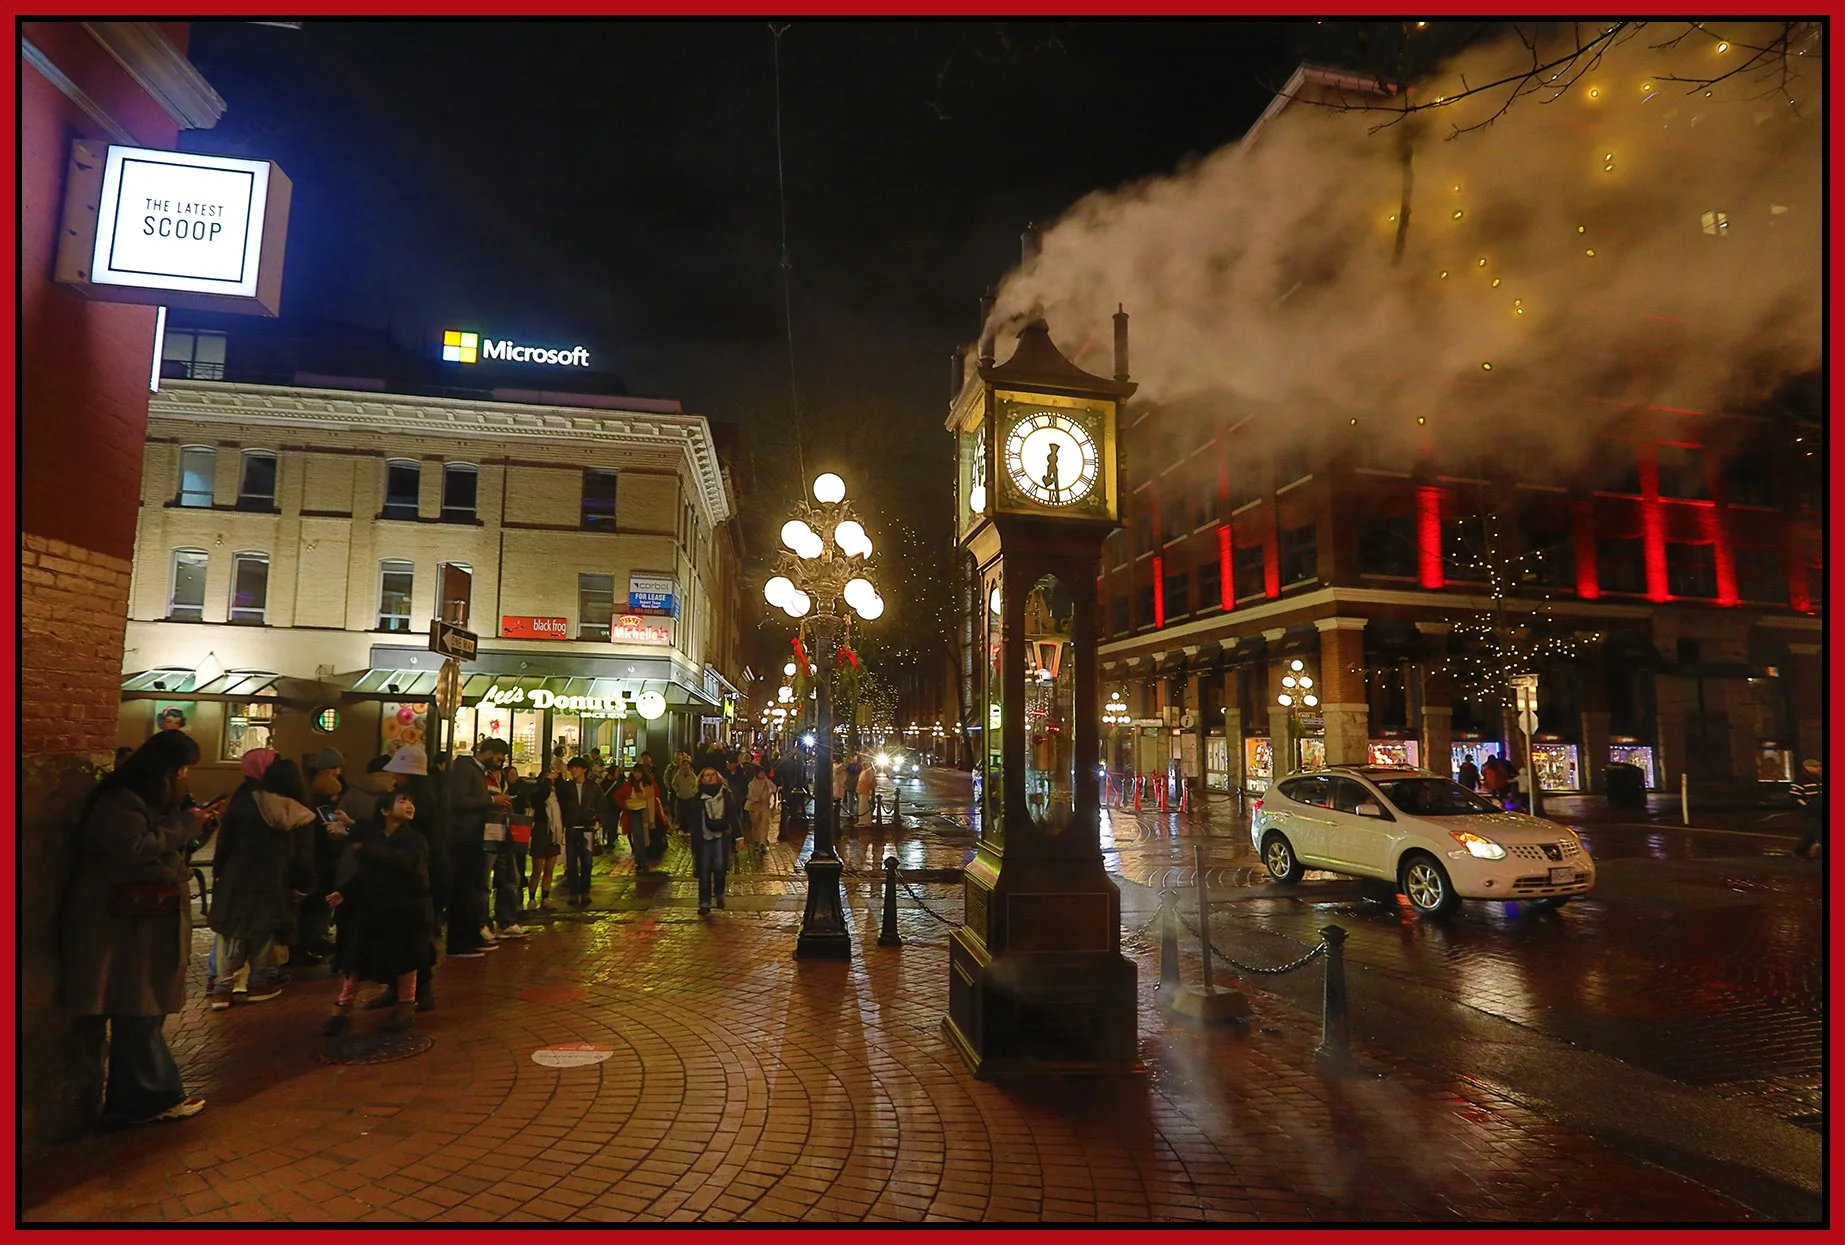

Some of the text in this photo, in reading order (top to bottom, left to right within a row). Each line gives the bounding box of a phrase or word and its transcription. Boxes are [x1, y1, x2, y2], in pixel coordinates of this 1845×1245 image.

[146, 198, 224, 217] THE LATEST
[143, 215, 222, 241] SCOOP
[483, 339, 590, 367] Microsoft
[533, 619, 566, 634] black frog
[621, 617, 641, 626] VISIT
[614, 626, 668, 641] Michelle's
[451, 635, 474, 652] ONE WAY
[476, 684, 627, 711] Lee's Donuts
[580, 711, 605, 719] SINCE
